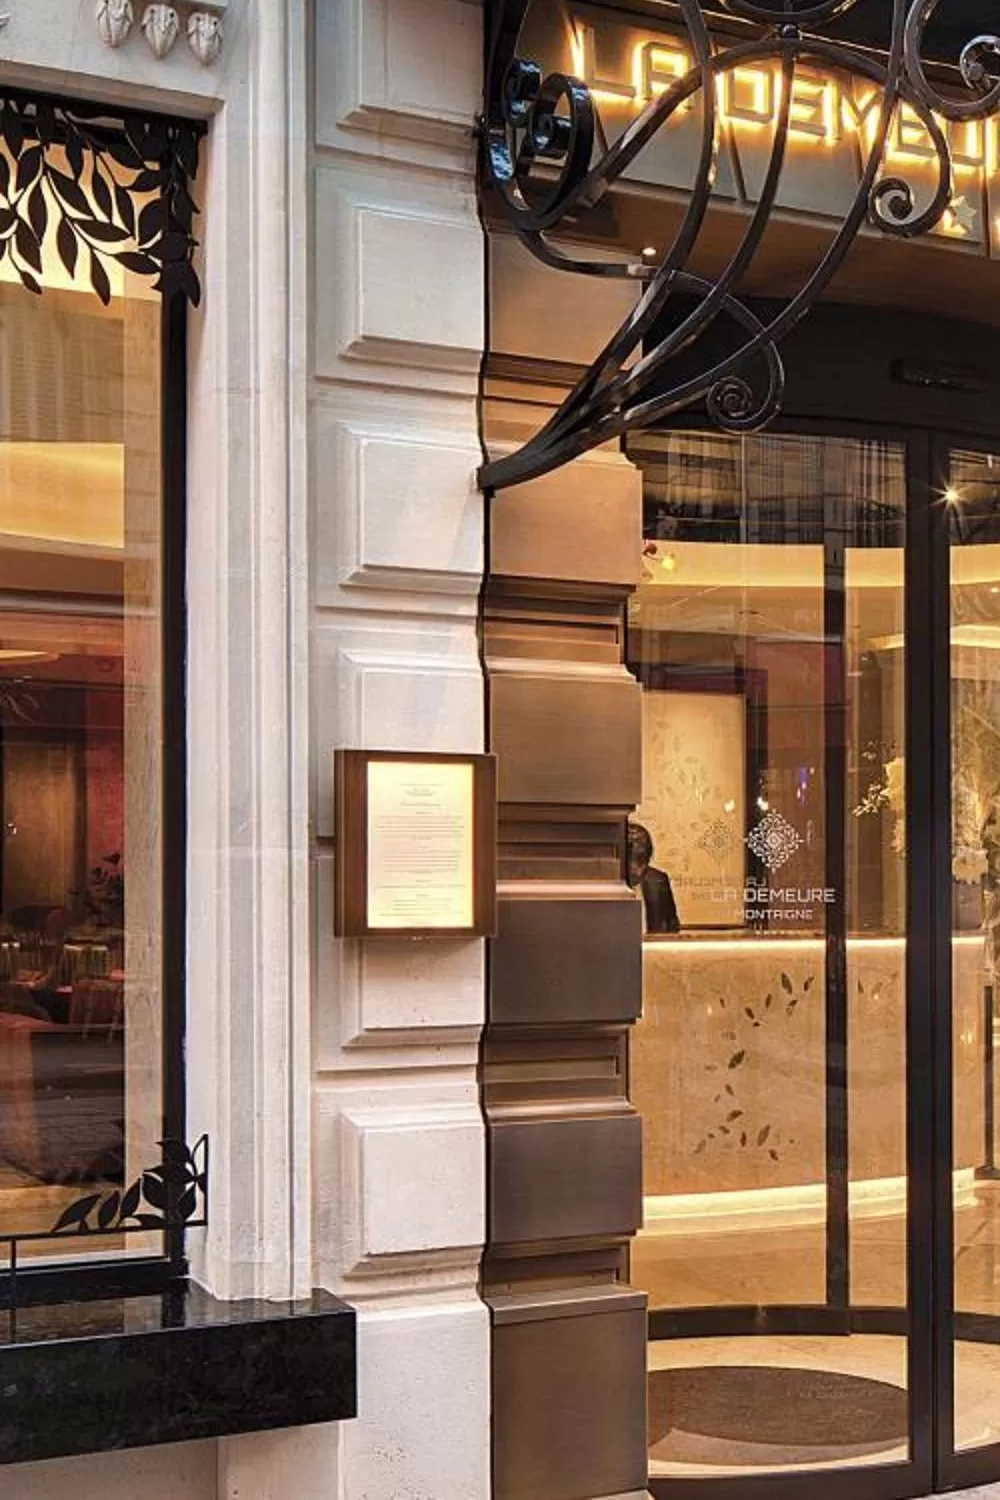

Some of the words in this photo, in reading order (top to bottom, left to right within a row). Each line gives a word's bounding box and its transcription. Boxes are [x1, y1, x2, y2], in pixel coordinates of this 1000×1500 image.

[574, 24, 693, 110] LA
[743, 886, 836, 902] DEMEURE
[734, 908, 814, 920] MONTAIGNE
